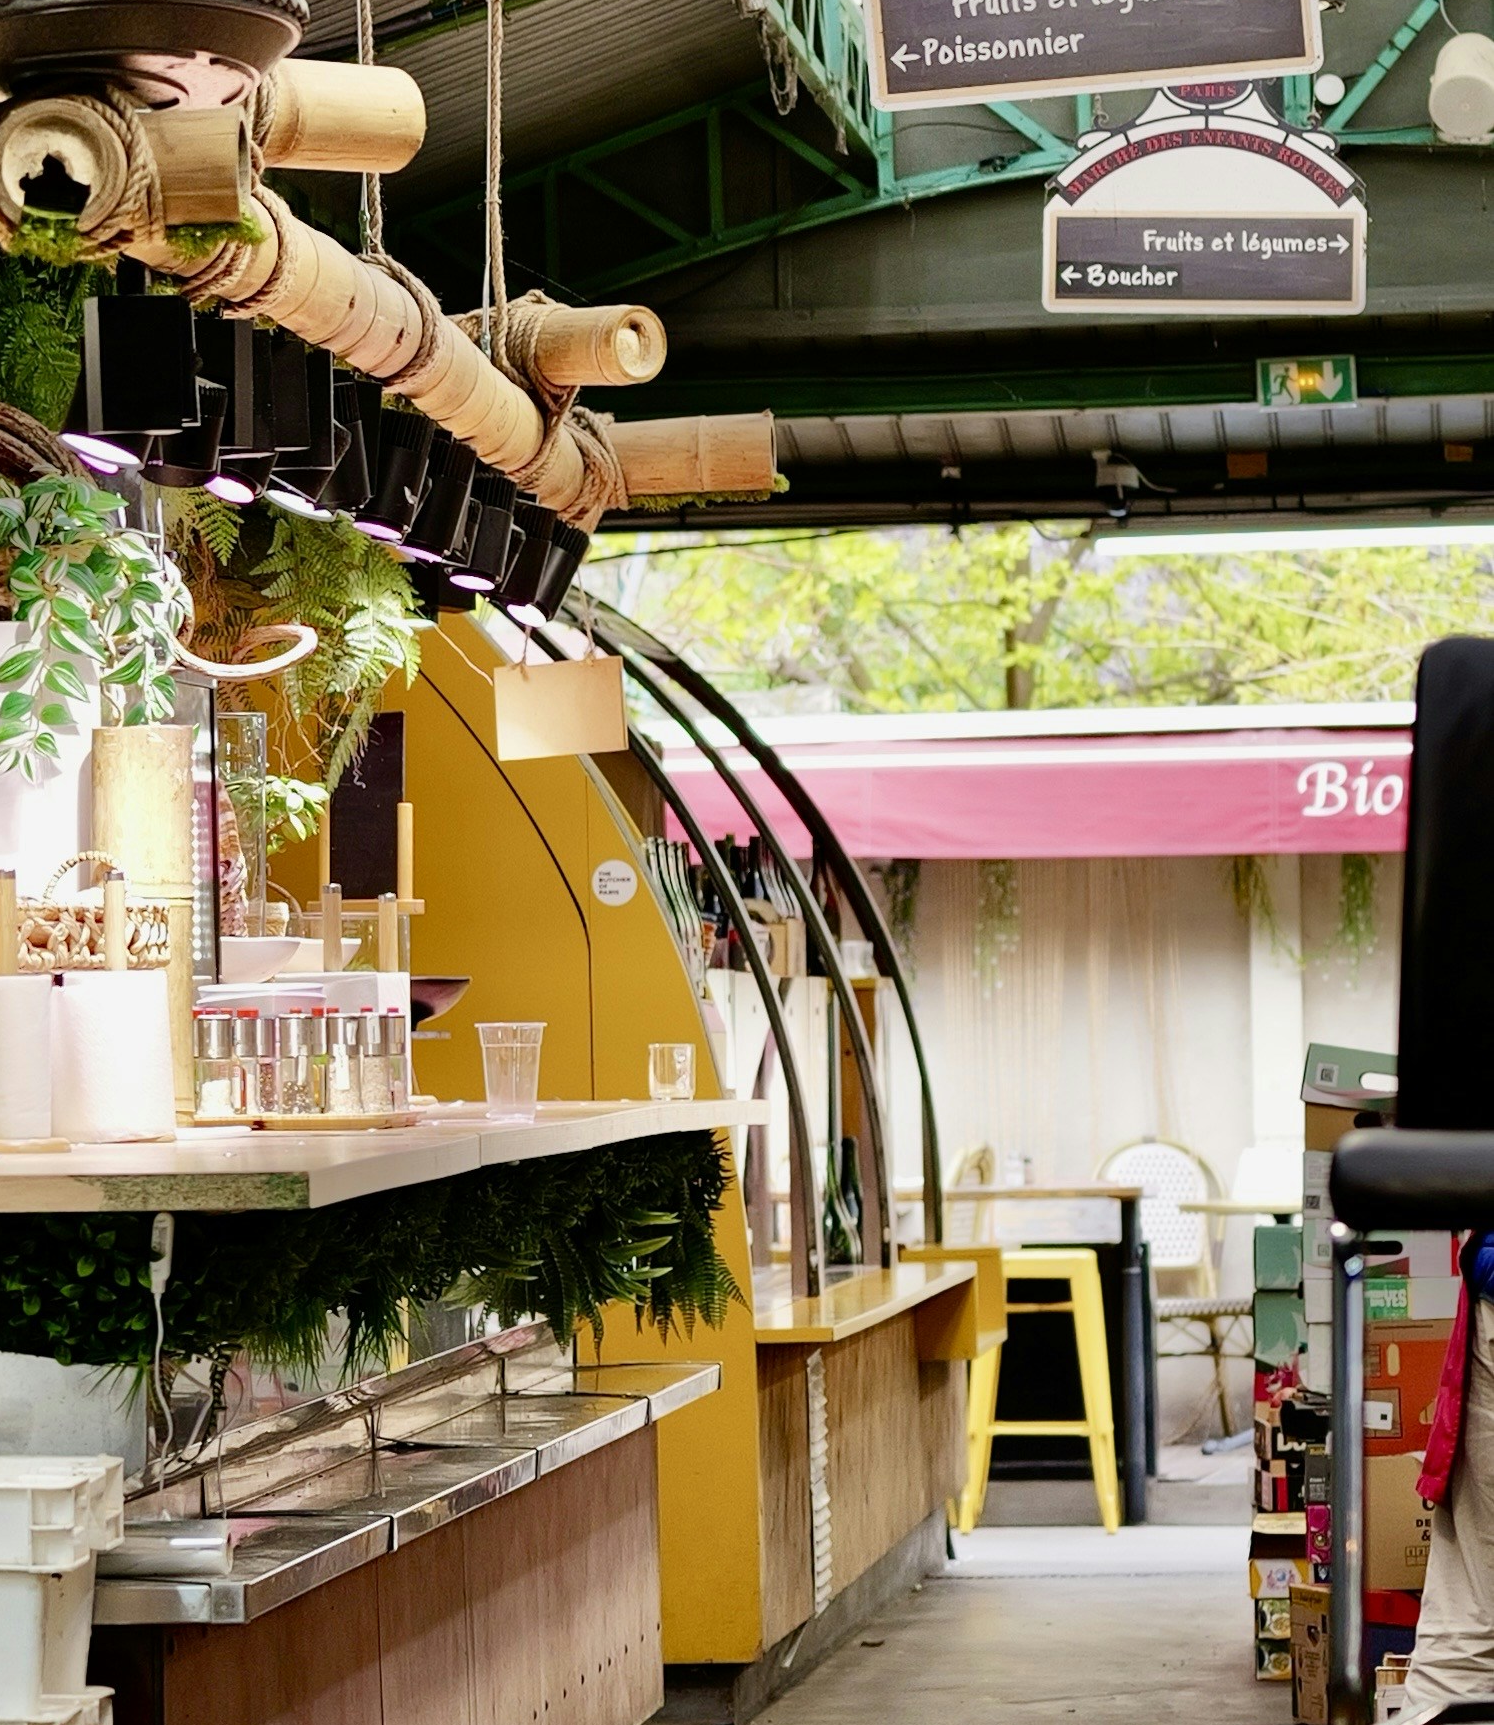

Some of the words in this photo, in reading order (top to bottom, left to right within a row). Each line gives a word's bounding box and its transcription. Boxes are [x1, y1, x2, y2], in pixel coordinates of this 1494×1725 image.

[921, 27, 1085, 67] Poissonnier
[1179, 83, 1237, 97] PARIS
[1145, 133, 1183, 152] DES
[1188, 129, 1274, 154] ENFANTS
[1275, 145, 1349, 201] ROUGES
[1142, 229, 1204, 253] Fruits
[1210, 231, 1235, 252] et
[1241, 229, 1328, 260] légumes
[1086, 264, 1179, 288] Boucher
[1296, 760, 1404, 817] Bio
